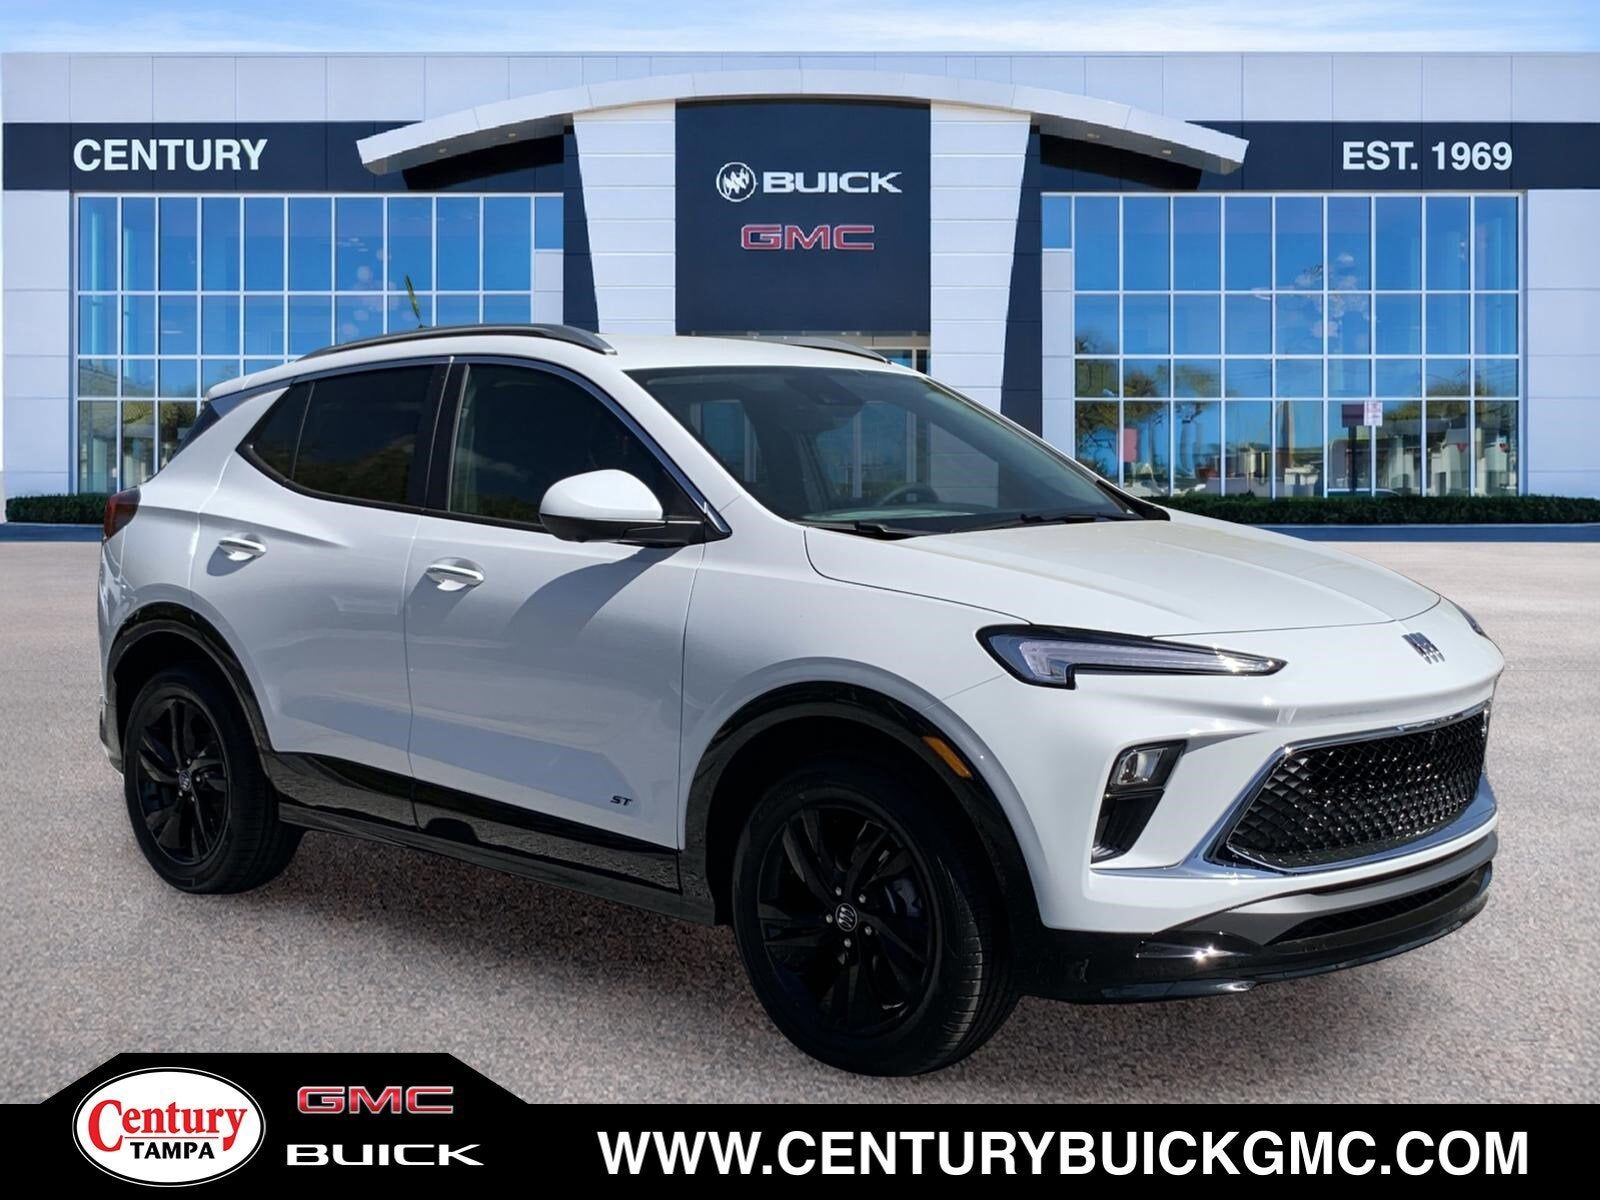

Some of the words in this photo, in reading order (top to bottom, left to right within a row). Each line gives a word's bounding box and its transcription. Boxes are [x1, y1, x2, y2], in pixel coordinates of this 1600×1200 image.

[73, 138, 267, 171] CENTURY
[1342, 141, 1417, 171] EST.
[1431, 141, 1513, 171] 1969
[763, 172, 902, 193] BUICK
[741, 224, 875, 250] GMC
[610, 795, 632, 806] ST
